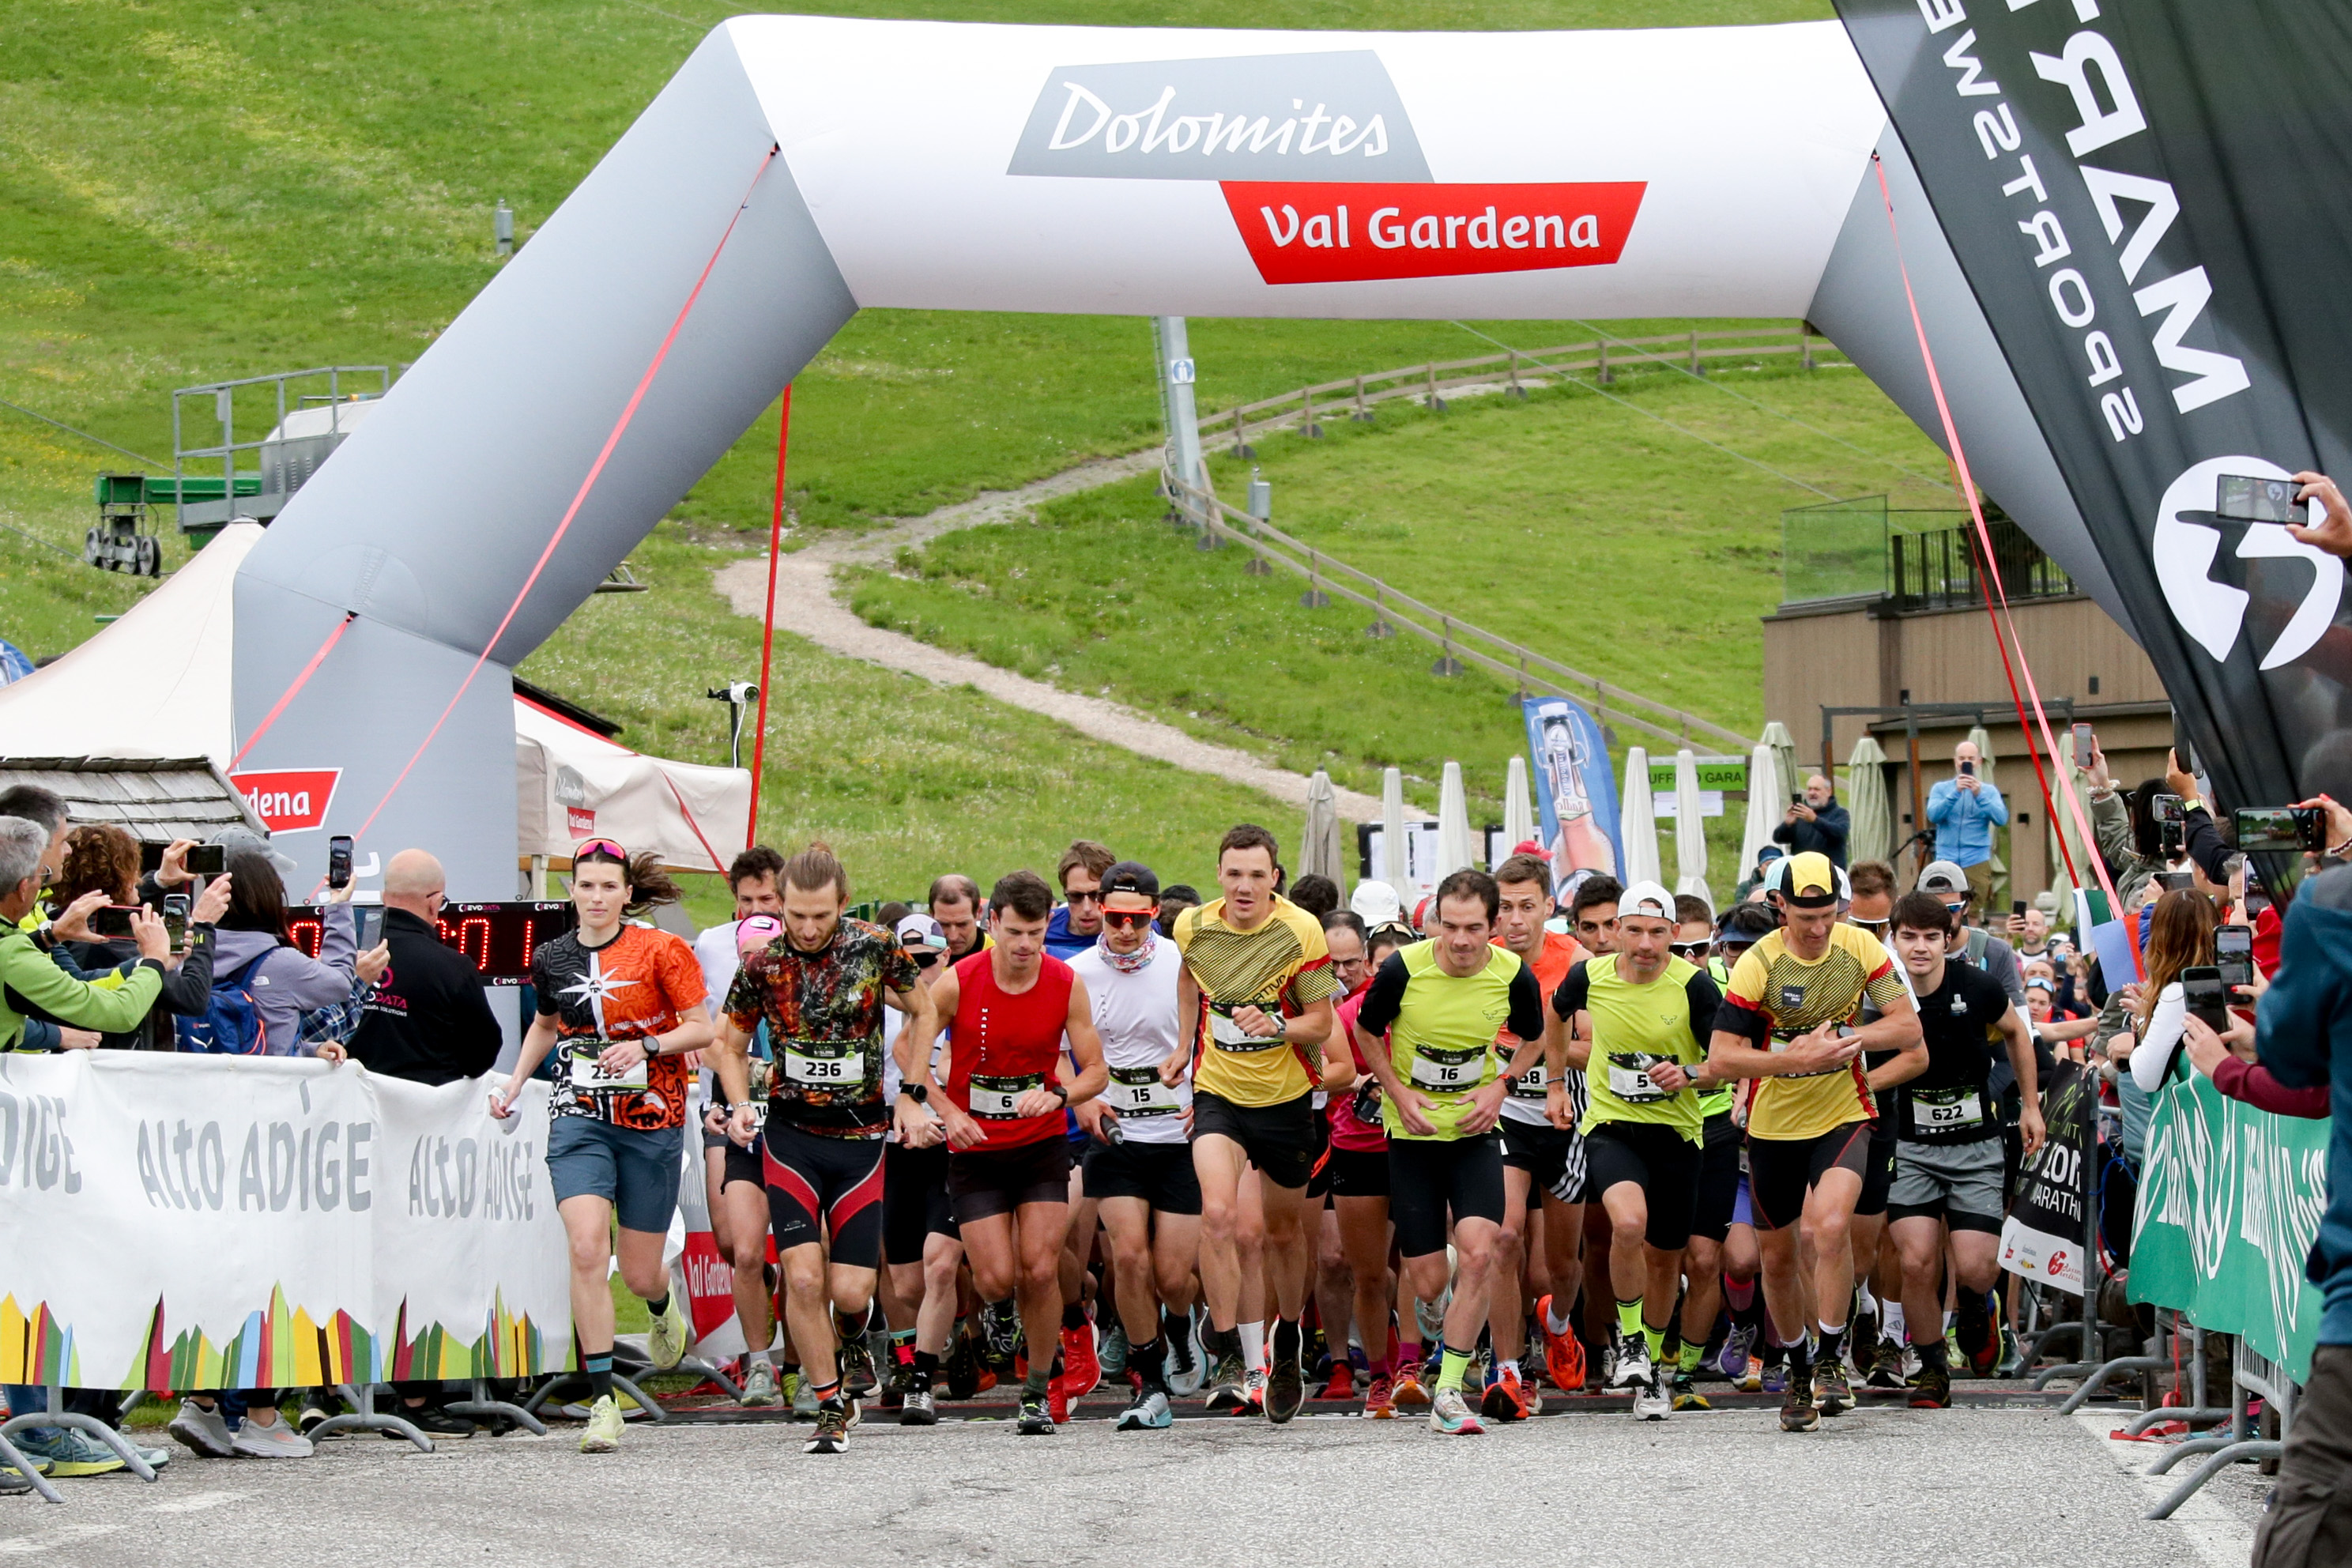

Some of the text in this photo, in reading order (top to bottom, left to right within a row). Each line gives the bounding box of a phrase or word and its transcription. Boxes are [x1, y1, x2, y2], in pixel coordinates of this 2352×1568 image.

[1047, 80, 1390, 157] Dolomites
[1260, 203, 1600, 251] Val Gardena
[1705, 771, 1743, 784] GARA
[805, 1061, 842, 1076] 236
[1440, 1068, 1459, 1080] 16
[1637, 1074, 1649, 1088] 5
[1001, 1095, 1013, 1108] 6
[1131, 1087, 1151, 1103] 15
[1932, 1105, 1964, 1121] 622
[238, 1080, 373, 1213] ADIGE
